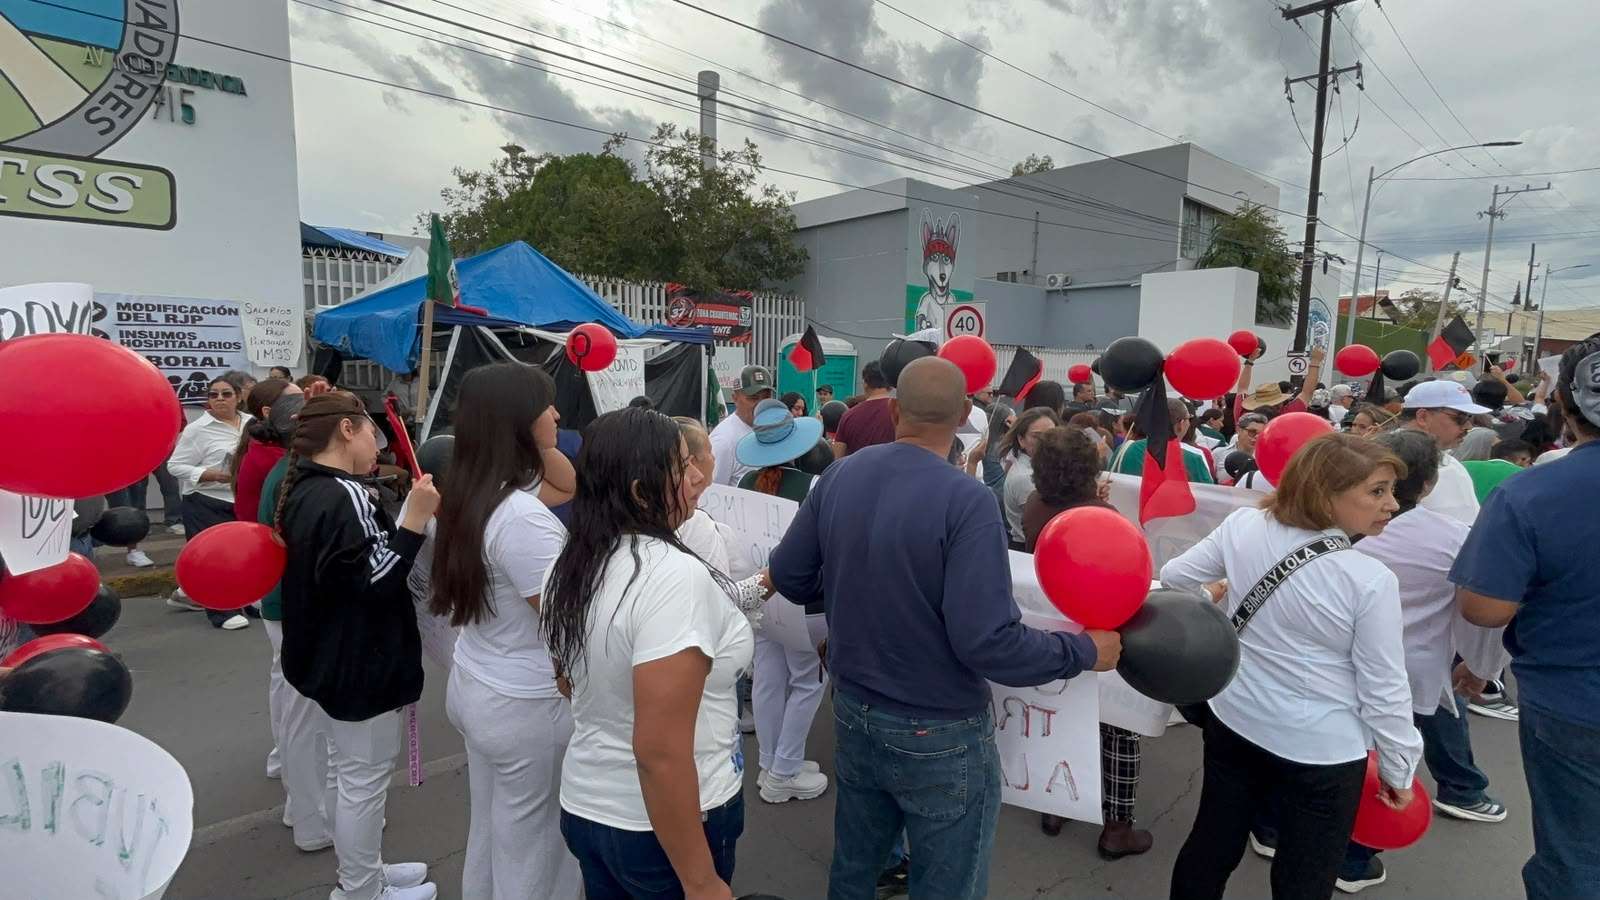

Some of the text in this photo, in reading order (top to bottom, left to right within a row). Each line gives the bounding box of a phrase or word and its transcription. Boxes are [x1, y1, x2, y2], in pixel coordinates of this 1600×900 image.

[116, 302, 239, 315] MODIFICACIÓN
[117, 312, 204, 324] DEL RJP
[955, 316, 975, 331] 40
[119, 330, 197, 340] INSUMOS
[120, 339, 242, 350] HOSPITALARIOS
[146, 355, 231, 367] BORAL
